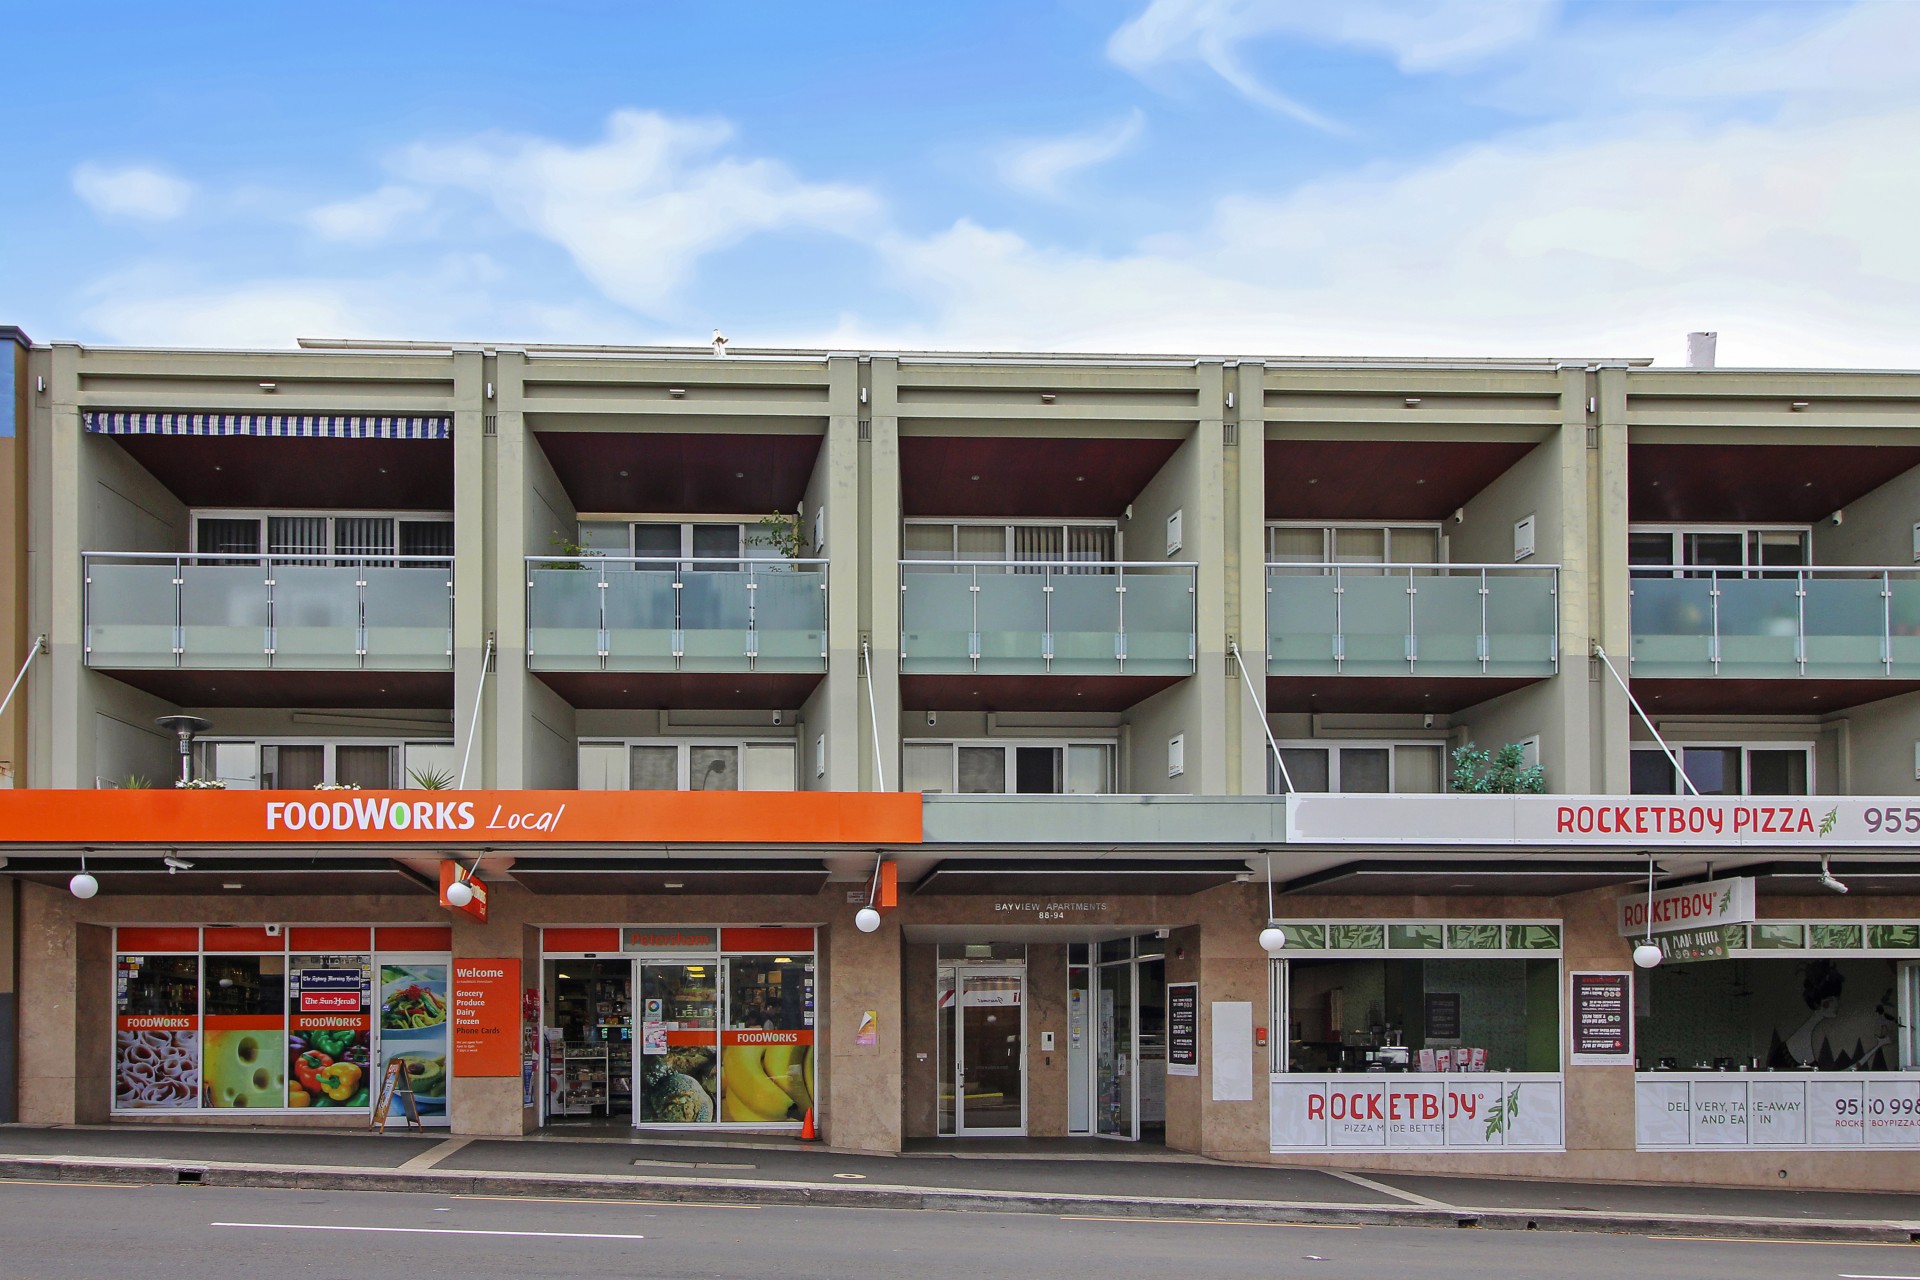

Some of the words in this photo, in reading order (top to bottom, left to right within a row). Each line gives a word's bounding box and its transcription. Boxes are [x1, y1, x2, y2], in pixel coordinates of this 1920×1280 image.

[266, 798, 475, 830] FOODWORKS
[485, 803, 566, 833] Local
[1557, 806, 1722, 834] ROCKETBOY
[1733, 807, 1815, 833] PIZZA
[995, 903, 1040, 911] BAYVIEW
[1046, 903, 1107, 911] APARTMENTS
[1038, 911, 1064, 919] 88-94
[631, 931, 710, 947] Petersham
[456, 967, 504, 978] Welcome
[456, 990, 484, 999] Grocery
[304, 997, 318, 1005] The
[456, 999, 486, 1007] Produce
[456, 1008, 476, 1017] Dairy
[127, 1017, 190, 1028] FOODWORKS
[300, 1017, 362, 1027] FOODWORKS
[737, 1032, 798, 1043] FOODWORKS
[1667, 1102, 1728, 1113] DELVERY,
[1732, 1102, 1801, 1112] TAE-AWAY
[1701, 1115, 1726, 1124] AND
[1760, 1115, 1772, 1124] IN
[1344, 1124, 1373, 1133] PIZZA
[1377, 1124, 1405, 1133] MDE
